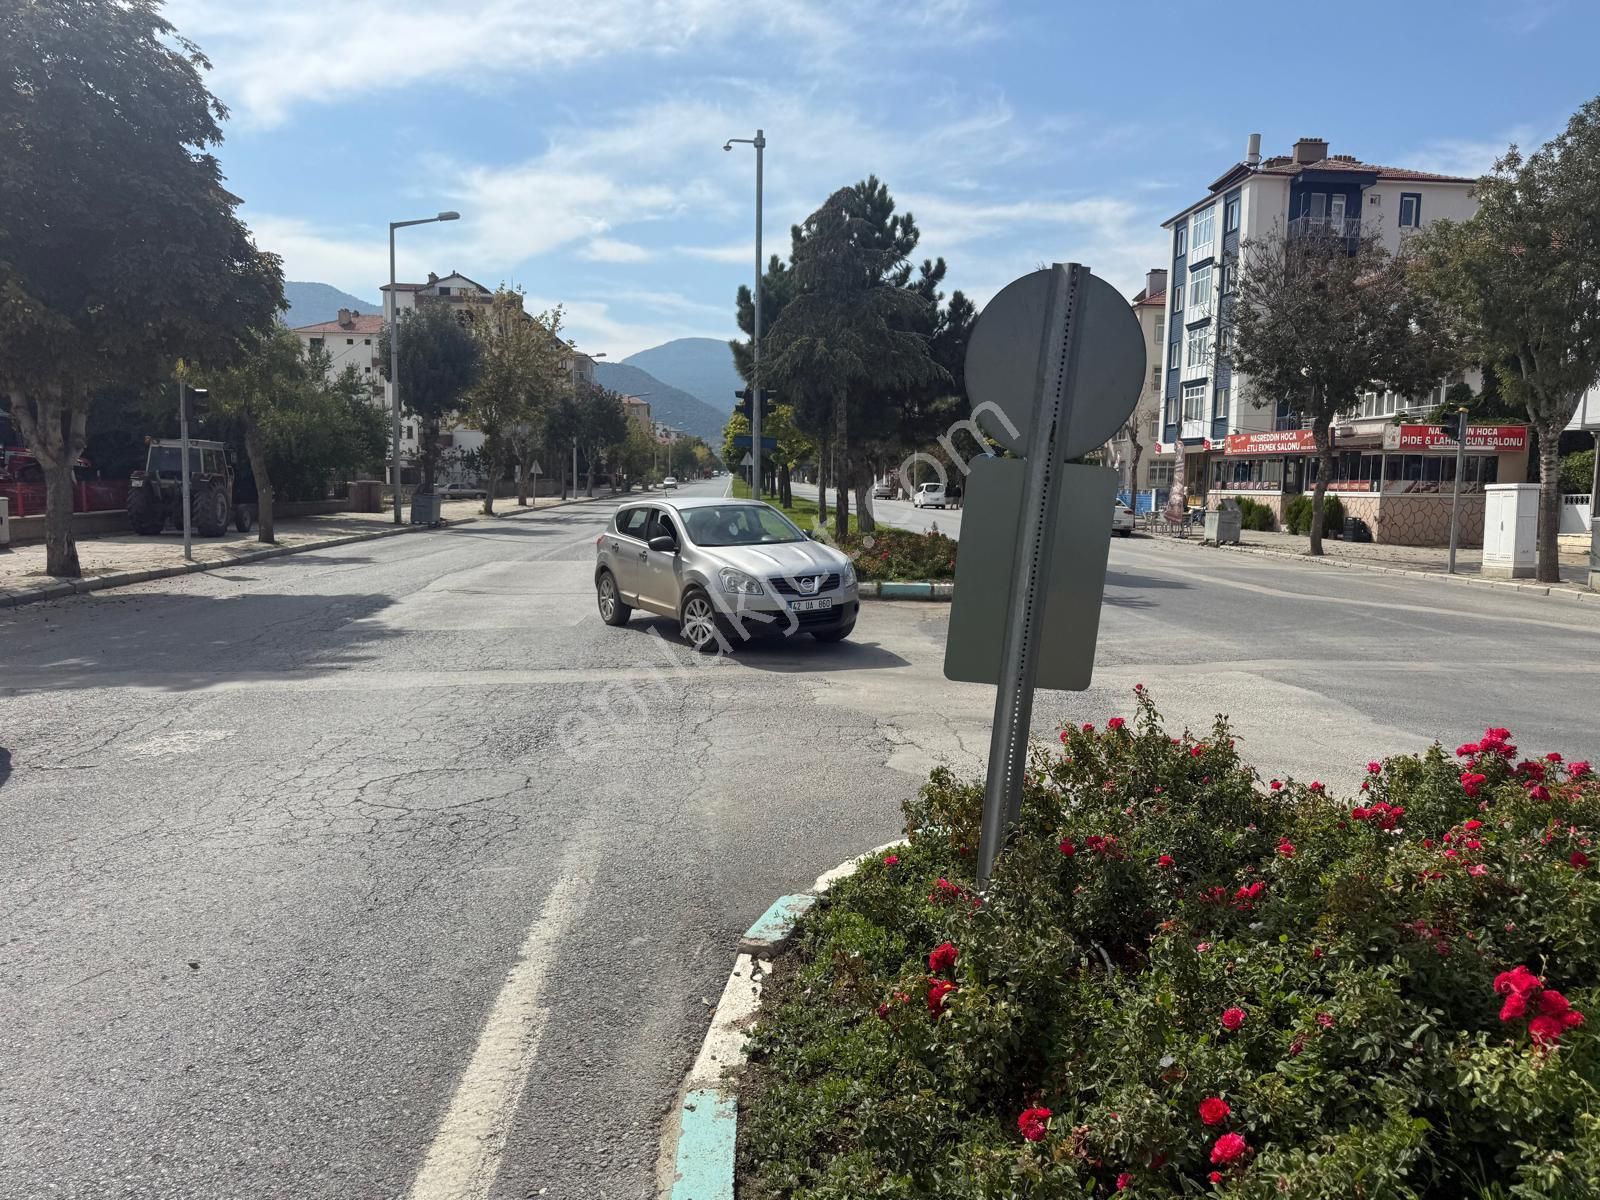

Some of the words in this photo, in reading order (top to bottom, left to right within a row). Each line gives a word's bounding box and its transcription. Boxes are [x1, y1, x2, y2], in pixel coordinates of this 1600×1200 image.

[1280, 431, 1297, 441] HOCA
[1477, 427, 1498, 436] HOCA
[1401, 434, 1422, 445] PİDE
[1425, 436, 1431, 445] &
[1434, 436, 1485, 446] LAHCUN
[1487, 437, 1523, 446] SALONU
[1258, 443, 1277, 452] EKMEK
[1277, 442, 1301, 451] SALONU
[793, 602, 801, 610] 42
[805, 601, 814, 609] UA
